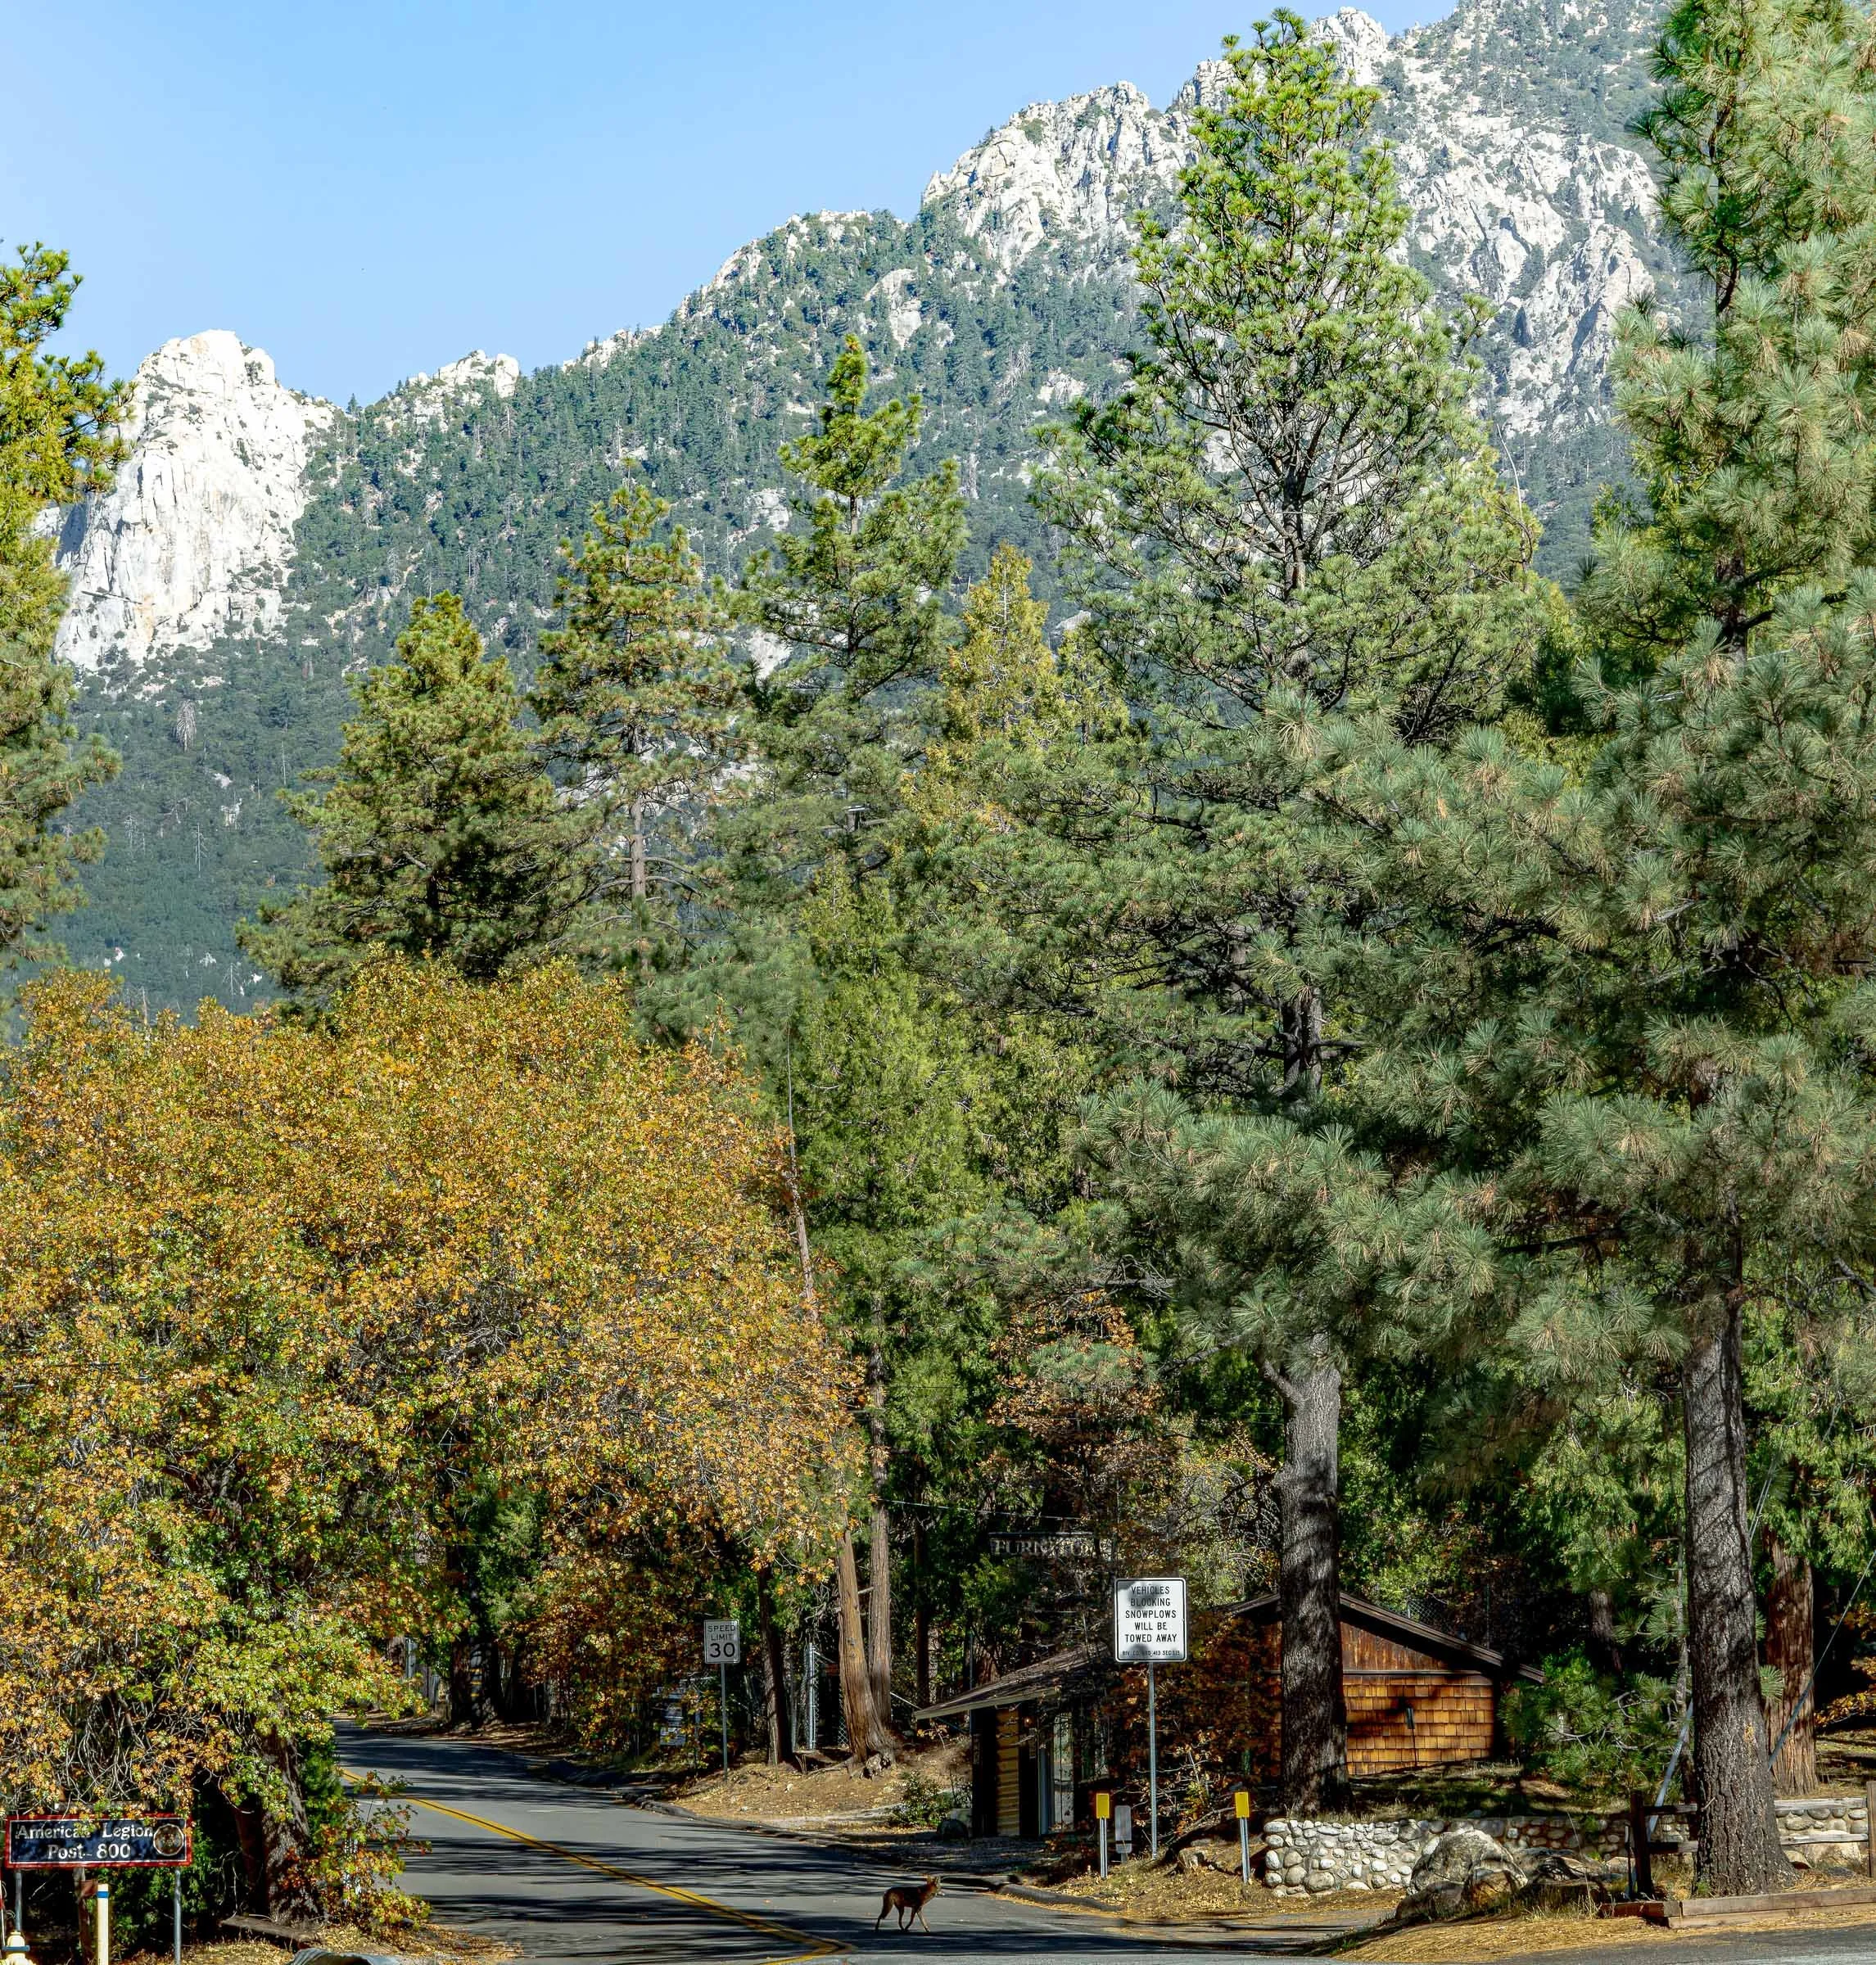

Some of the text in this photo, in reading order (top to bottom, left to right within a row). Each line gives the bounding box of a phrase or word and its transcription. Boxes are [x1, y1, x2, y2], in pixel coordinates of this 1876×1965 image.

[1131, 1586, 1170, 1595] VEHICLES
[1130, 1598, 1171, 1606] BLOCKING
[1125, 1610, 1177, 1619] SNOWPLOWS
[1134, 1622, 1168, 1631] WILL BE
[1124, 1633, 1178, 1642] TOWED AWAY
[710, 1642, 735, 1658] 30
[102, 1823, 153, 1840] Legion
[47, 1843, 131, 1859] Post 800
